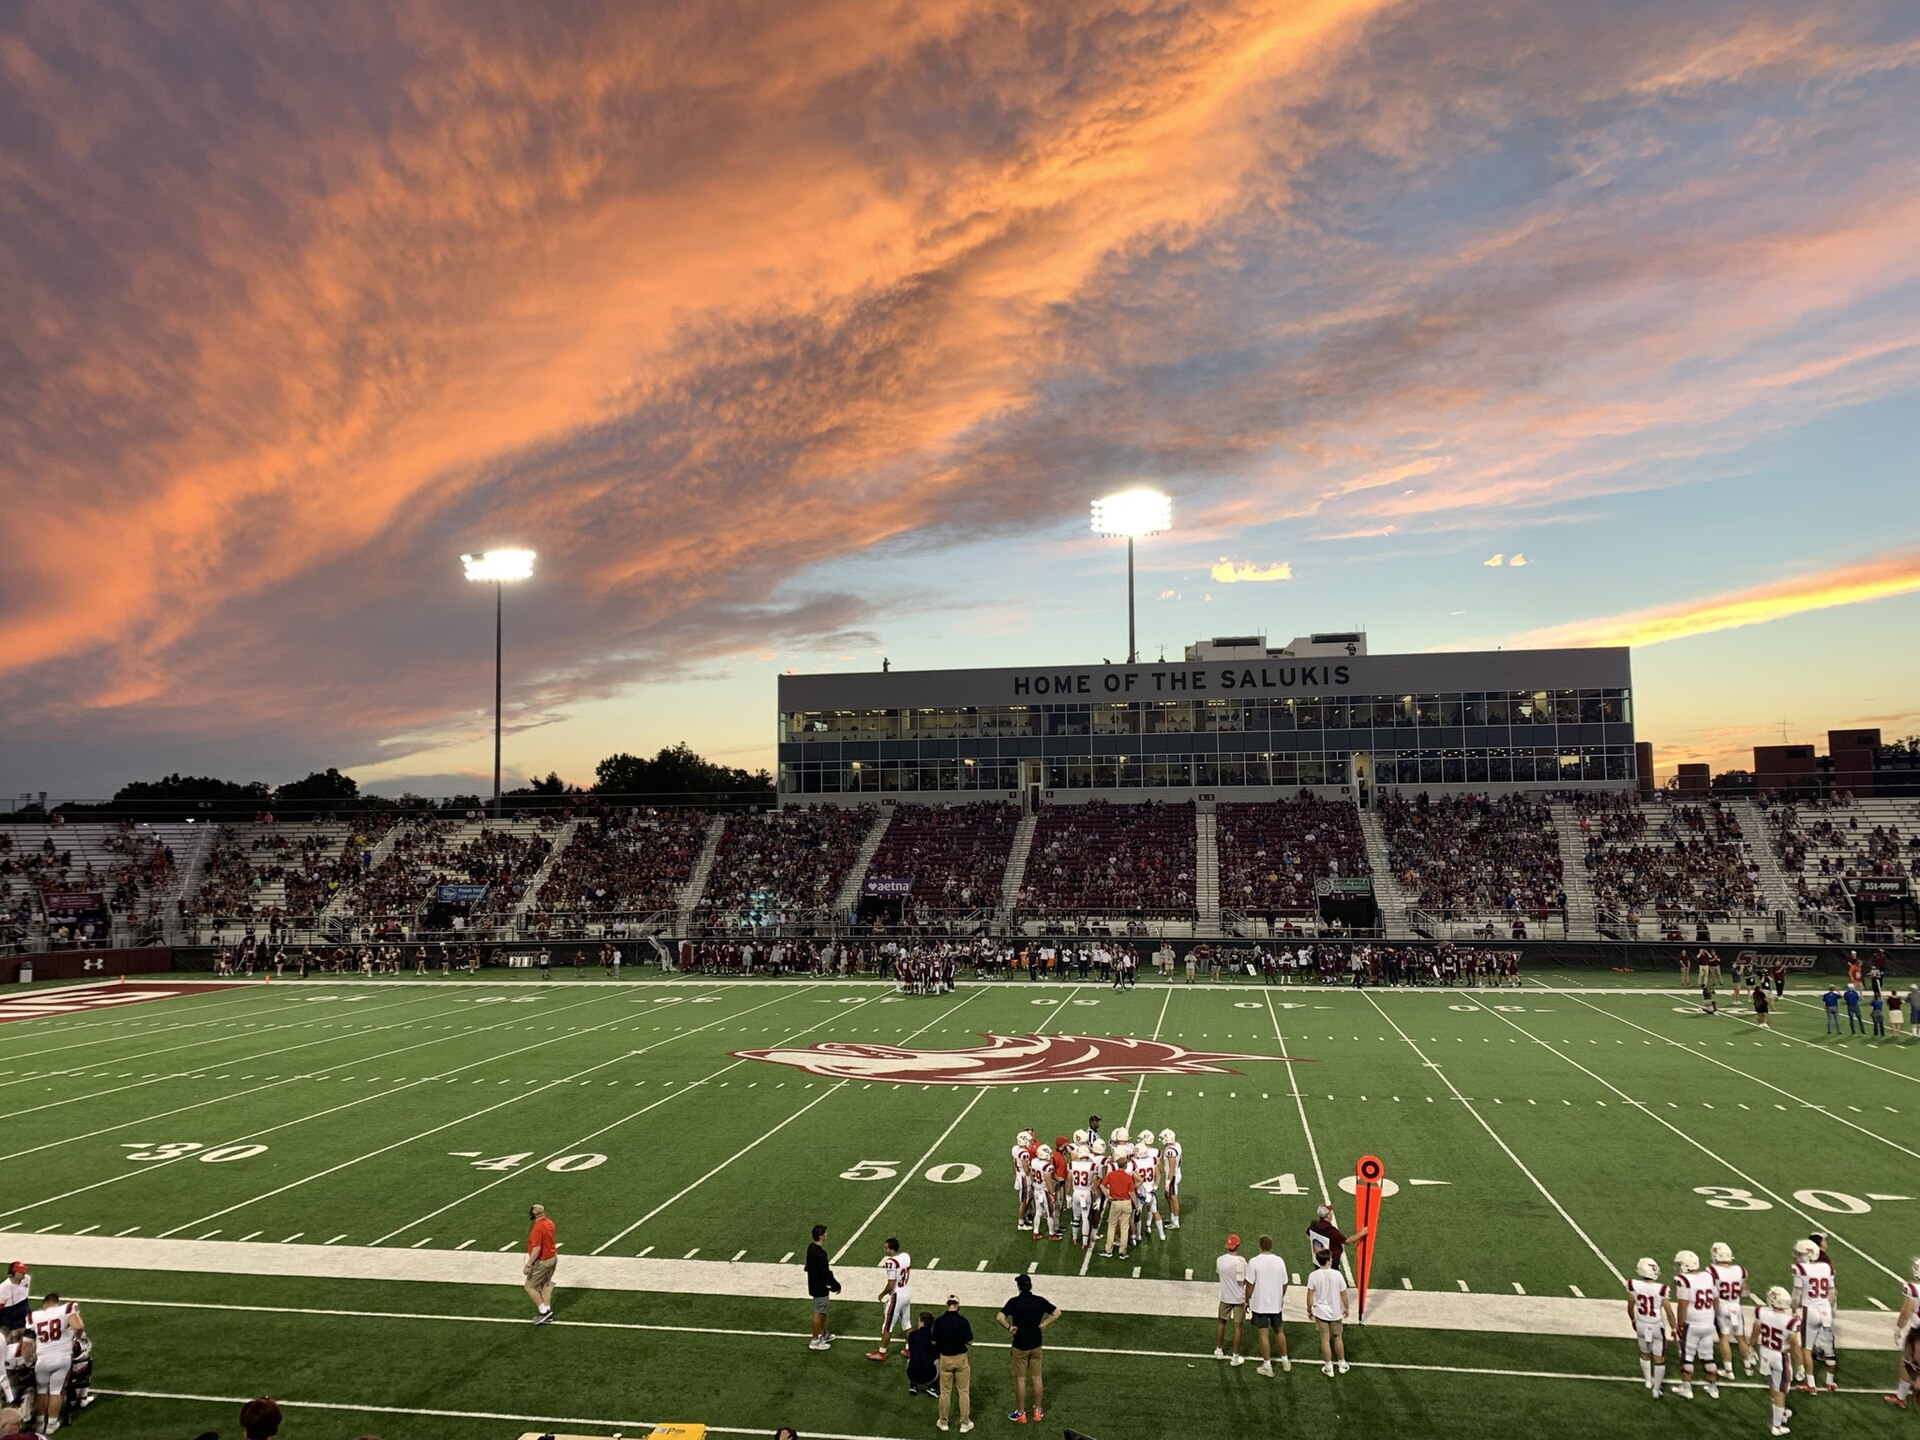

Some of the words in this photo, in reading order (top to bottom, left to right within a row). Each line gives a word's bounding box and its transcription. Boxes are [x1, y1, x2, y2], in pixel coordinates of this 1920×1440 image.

[1014, 675, 1091, 695] HOME
[1104, 673, 1138, 692] OF
[1151, 670, 1207, 691] THE
[1220, 665, 1351, 689] SALUKIS
[877, 882, 909, 891] aetna
[1864, 882, 1899, 891] 351-9999
[1736, 950, 1818, 968] SALUKIS
[839, 1160, 983, 1183] 50
[1073, 1170, 1089, 1187] 33
[1692, 1187, 1872, 1214] 30
[1719, 1282, 1741, 1301] 26
[1808, 1278, 1829, 1298] 39
[1637, 1294, 1657, 1317] 31
[37, 1318, 61, 1343] 58
[1760, 1323, 1783, 1351] 25
